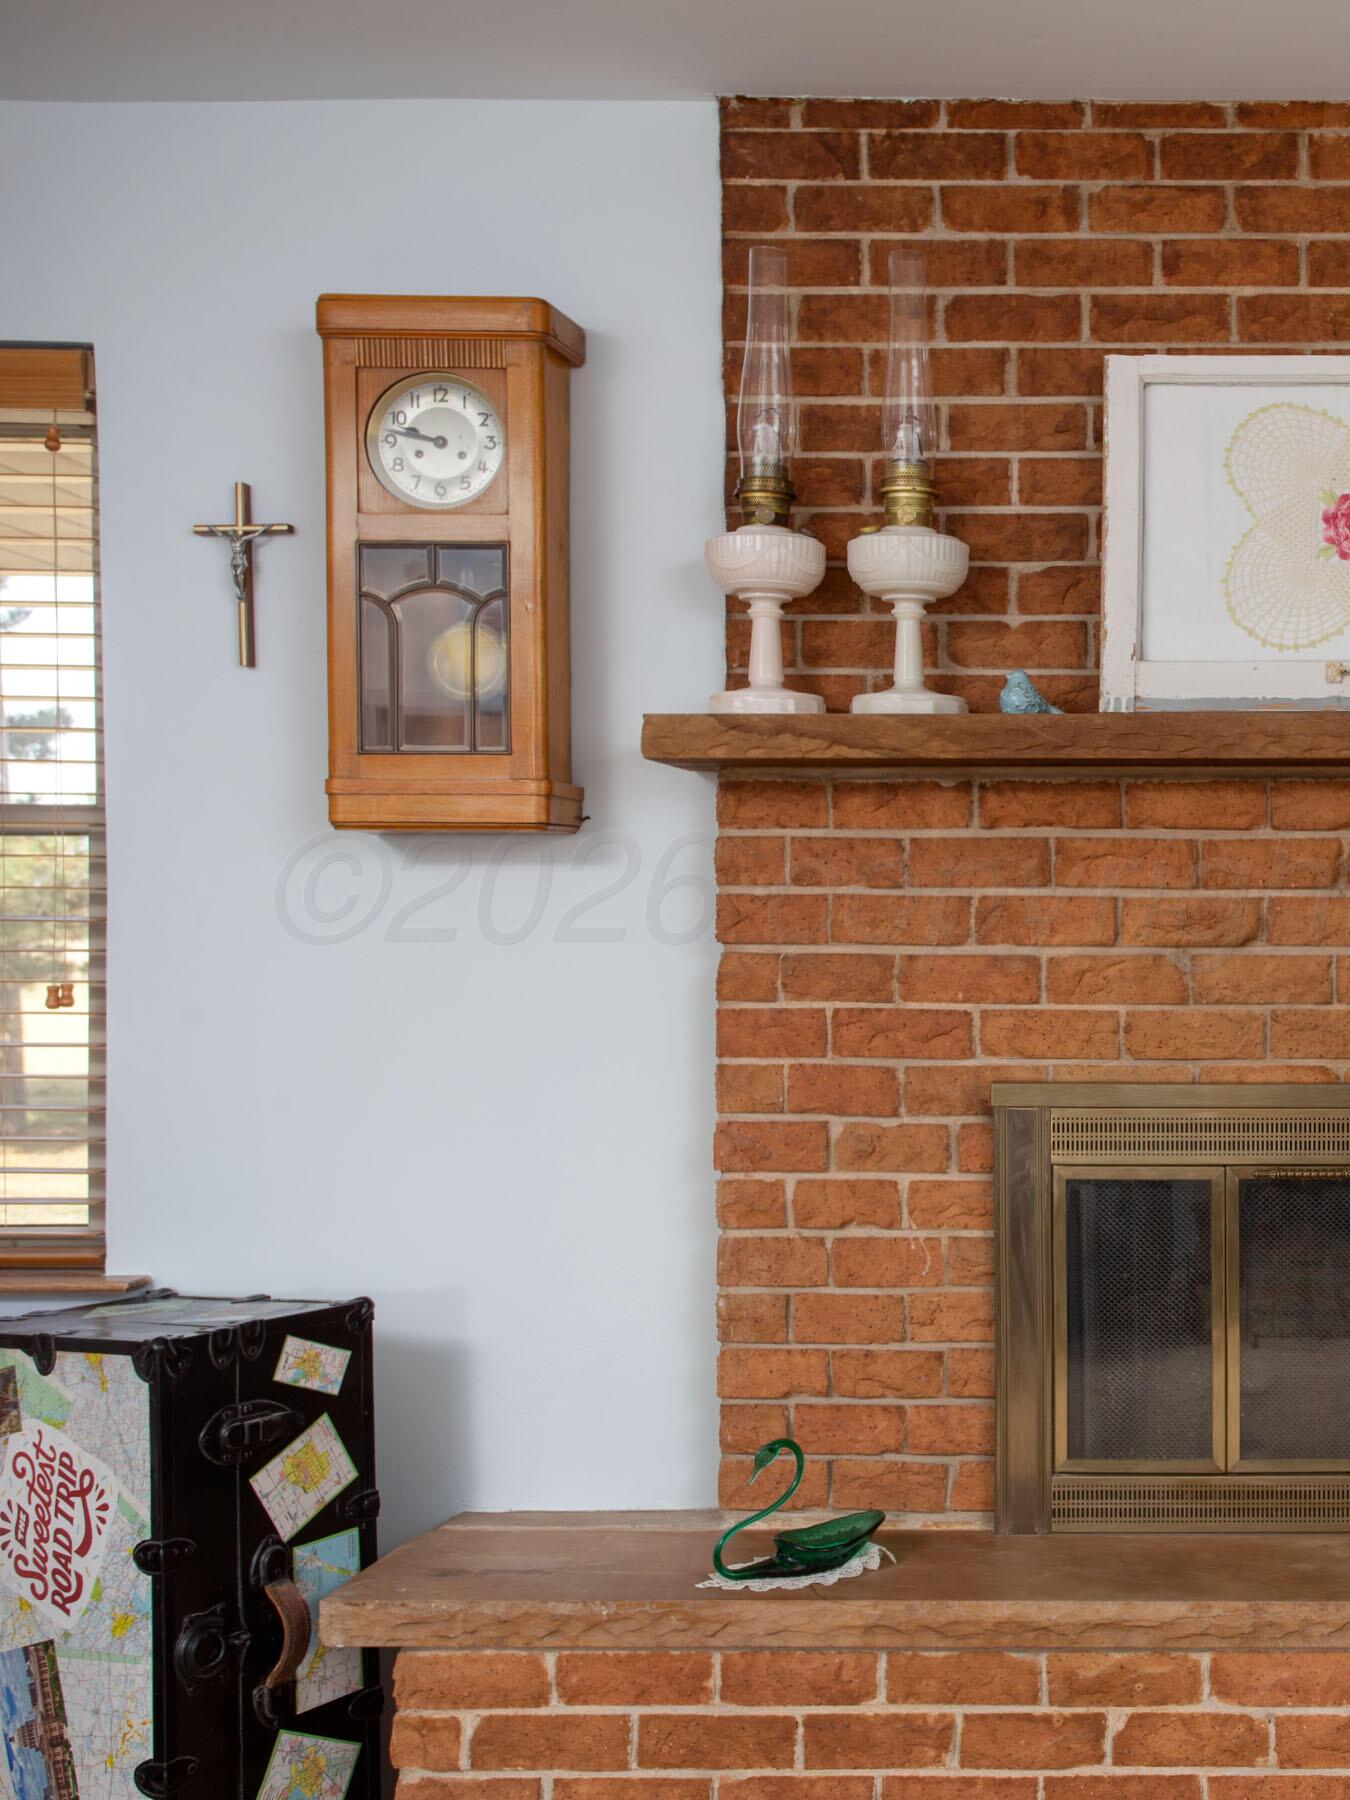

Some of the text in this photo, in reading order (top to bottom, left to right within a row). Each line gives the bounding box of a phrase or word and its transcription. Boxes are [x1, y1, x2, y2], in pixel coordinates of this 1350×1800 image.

[410, 392, 420, 408] 11
[433, 388, 448, 403] 12
[392, 411, 407, 426] 10
[477, 412, 490, 427] 2
[384, 433, 397, 448] 9
[484, 436, 496, 450] 3
[392, 457, 404, 472] 8
[477, 459, 489, 473] 4
[411, 475, 422, 490] 7
[434, 482, 447, 497] 6
[460, 476, 471, 490] 5
[13, 1429, 56, 1600] Sweetest
[16, 1504, 29, 1548] THE
[51, 1528, 83, 1616] ROAD
